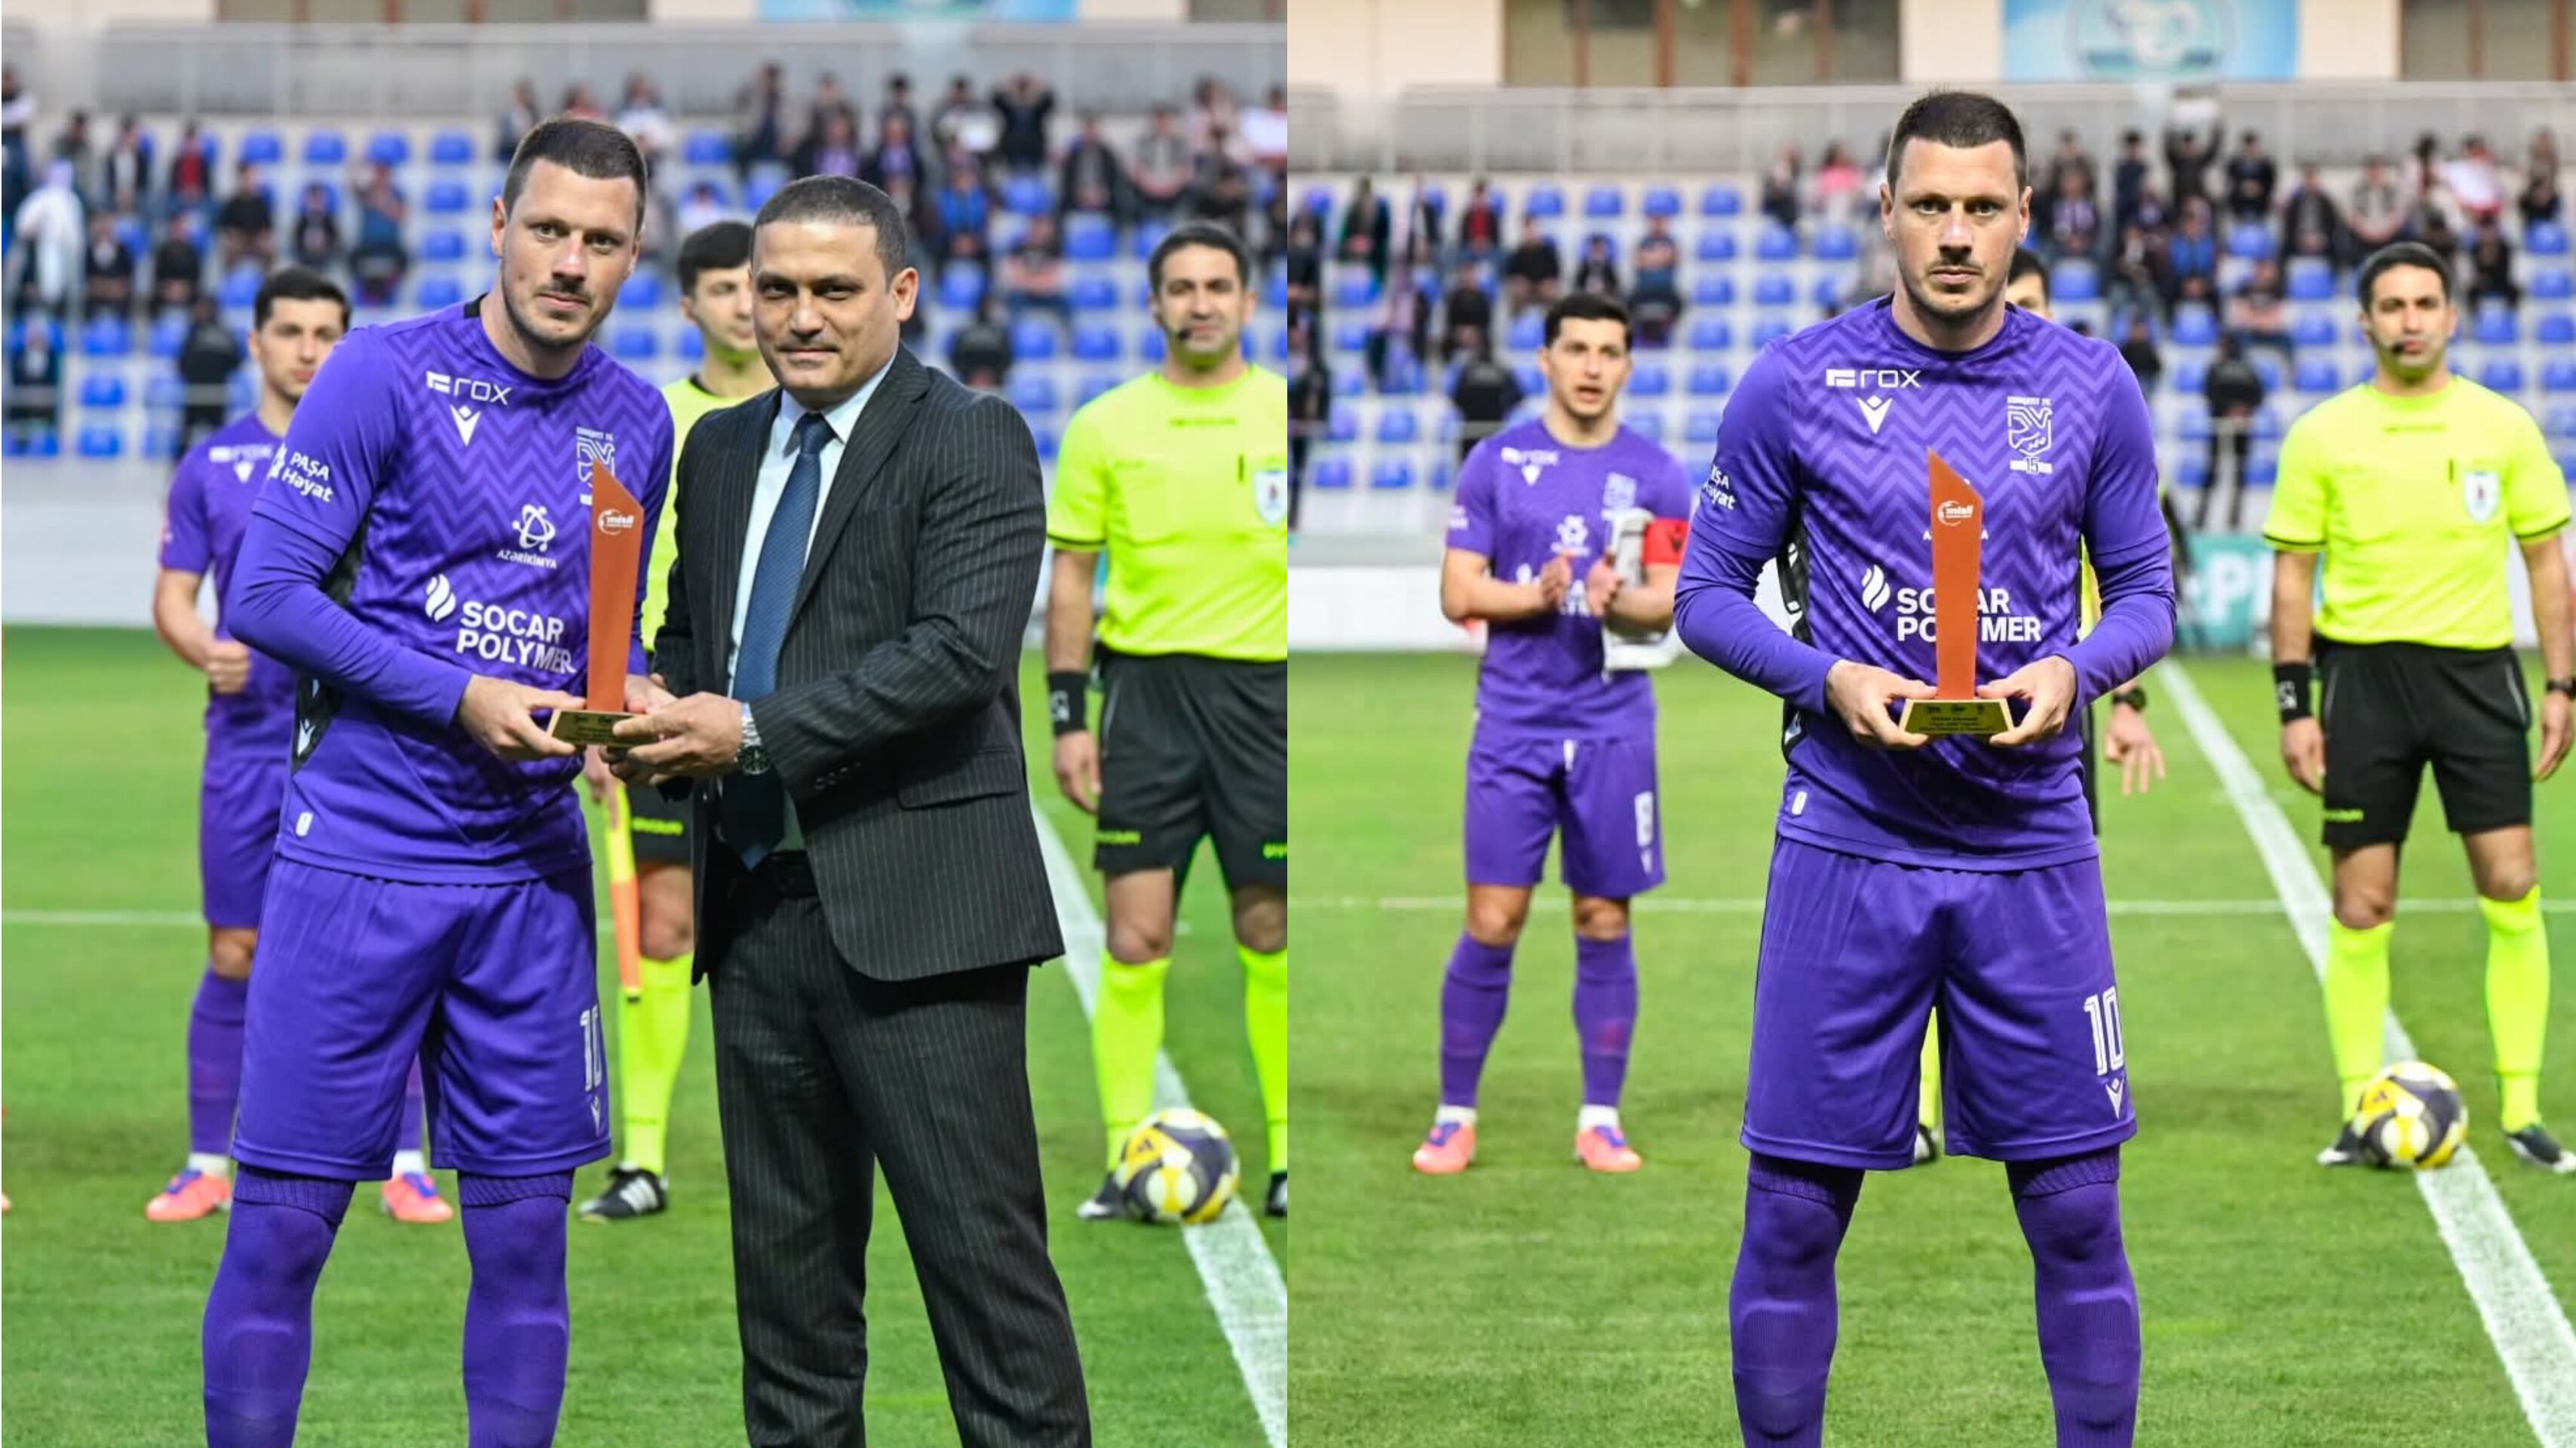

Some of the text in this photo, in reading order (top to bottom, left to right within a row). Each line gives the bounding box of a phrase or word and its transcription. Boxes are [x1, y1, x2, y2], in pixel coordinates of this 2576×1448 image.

[290, 451, 330, 480] PAŞA
[1896, 587, 2010, 614] SOAR
[460, 601, 564, 643] SOCAR
[1897, 616, 2042, 643] POMER
[455, 628, 578, 674] POLYMER
[2084, 986, 2124, 1076] 10
